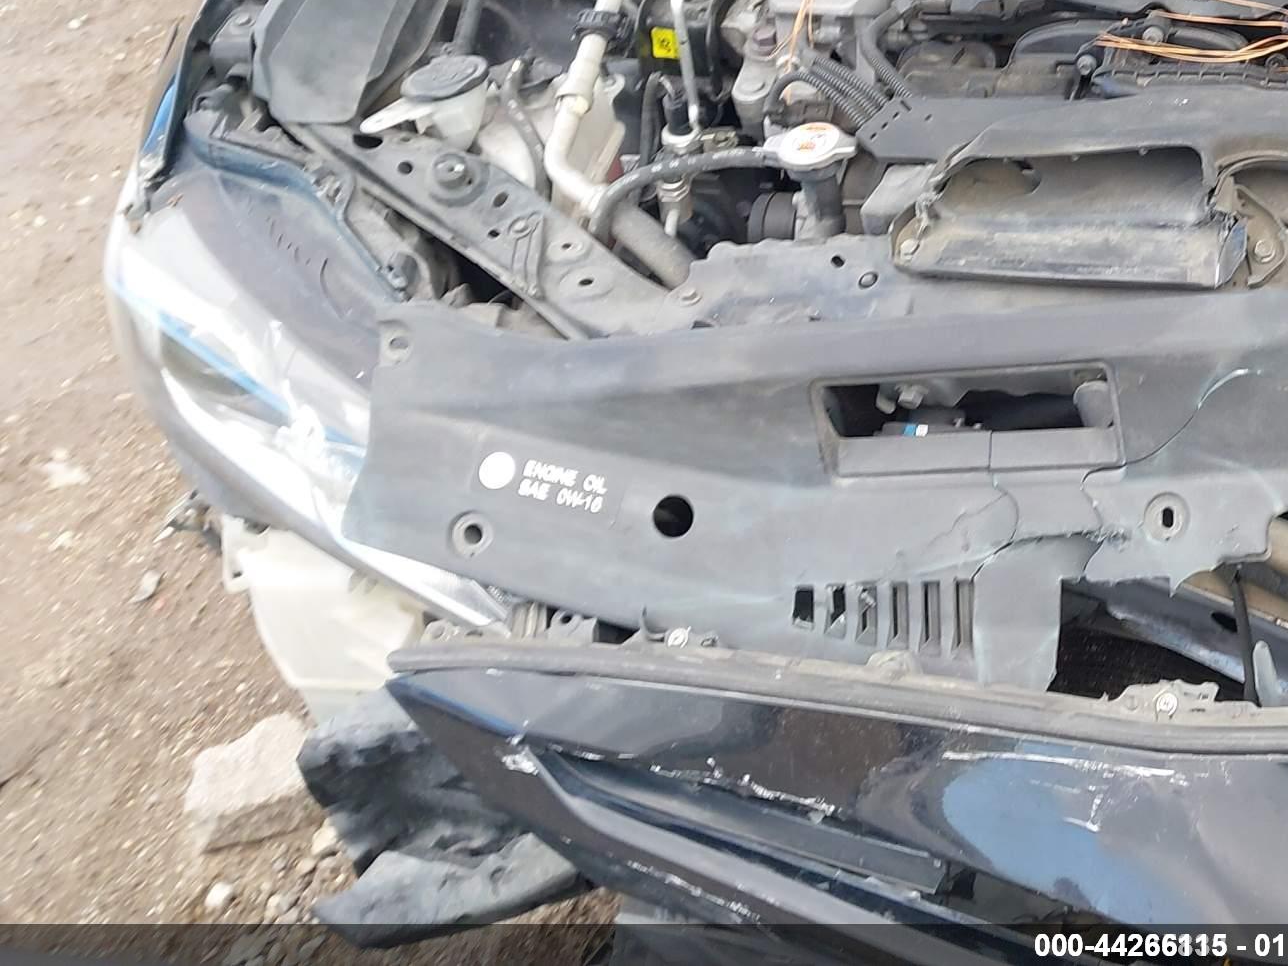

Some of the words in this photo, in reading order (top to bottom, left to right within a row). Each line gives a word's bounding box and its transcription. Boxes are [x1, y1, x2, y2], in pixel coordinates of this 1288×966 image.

[518, 478, 552, 501] SAE
[522, 459, 579, 488] ENGINE
[583, 473, 608, 495] OIL
